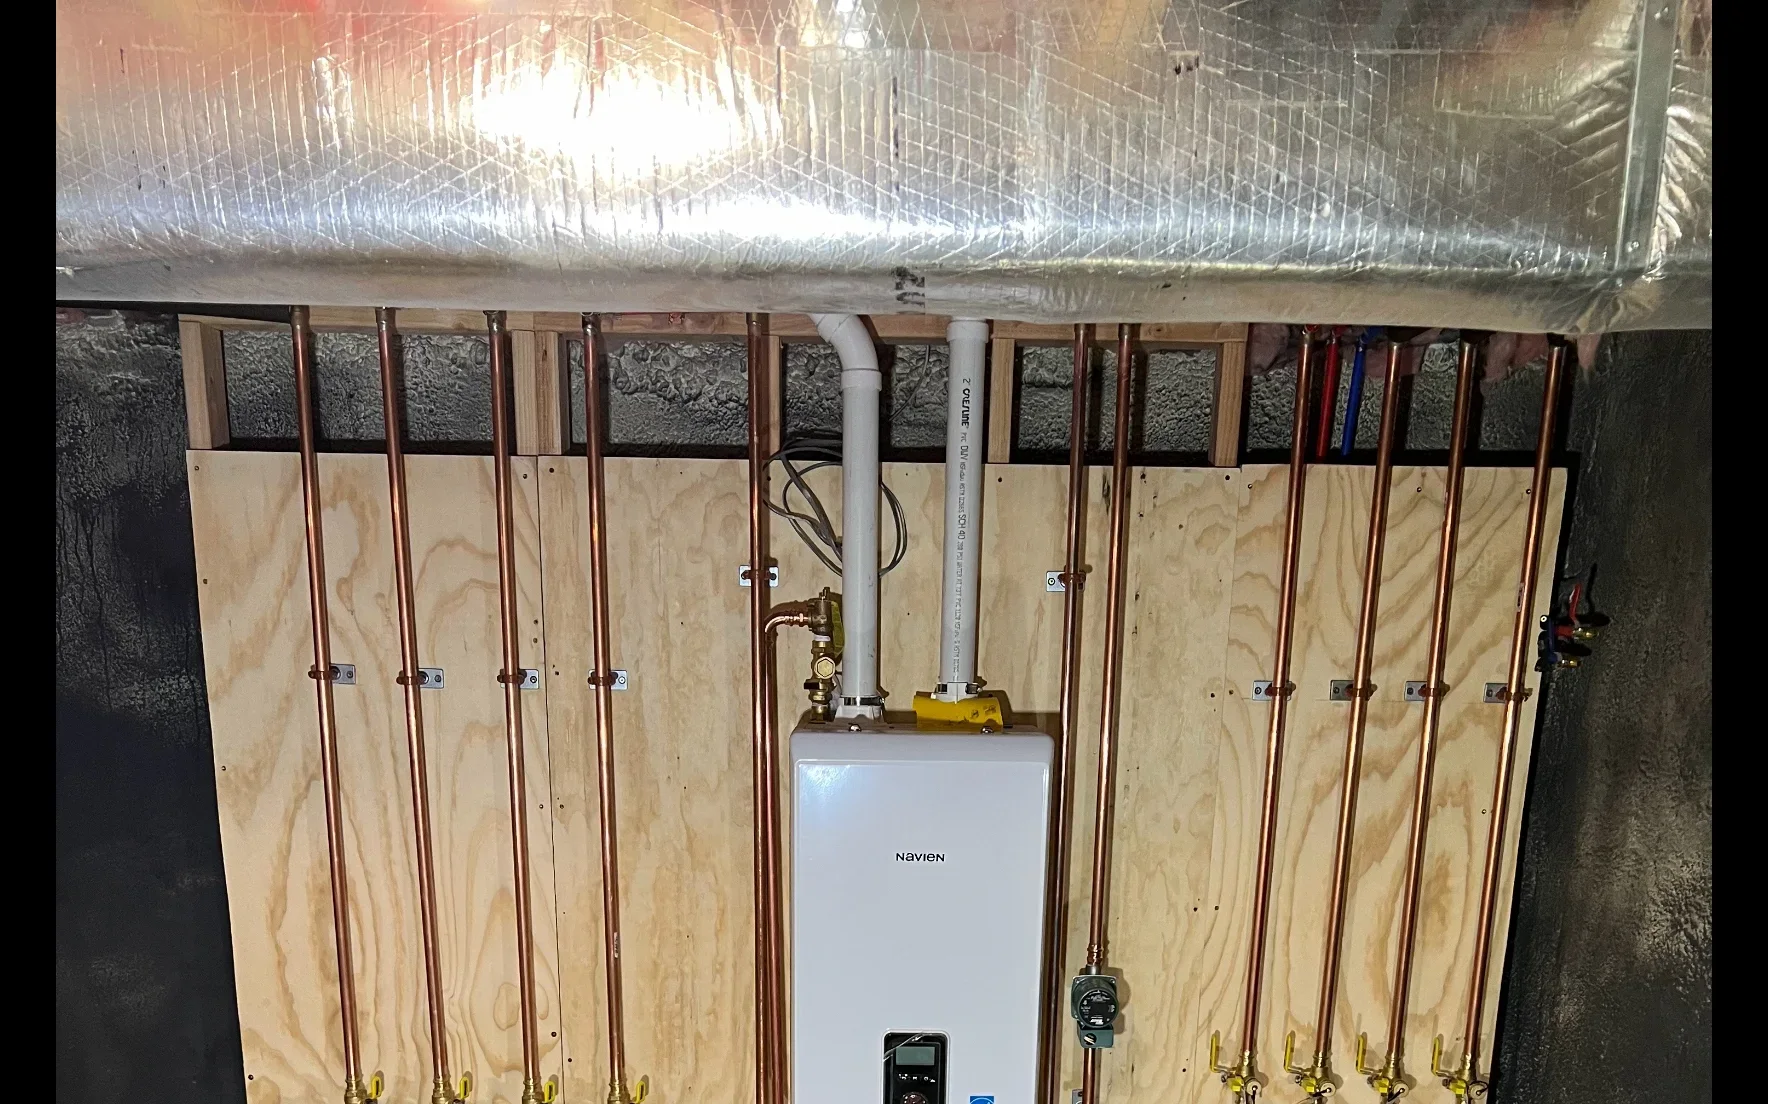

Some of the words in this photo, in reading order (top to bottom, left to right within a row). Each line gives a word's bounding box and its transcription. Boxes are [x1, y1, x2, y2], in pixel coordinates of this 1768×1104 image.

[960, 445, 969, 460] DWV
[958, 514, 966, 528] SCH
[957, 530, 966, 540] 40
